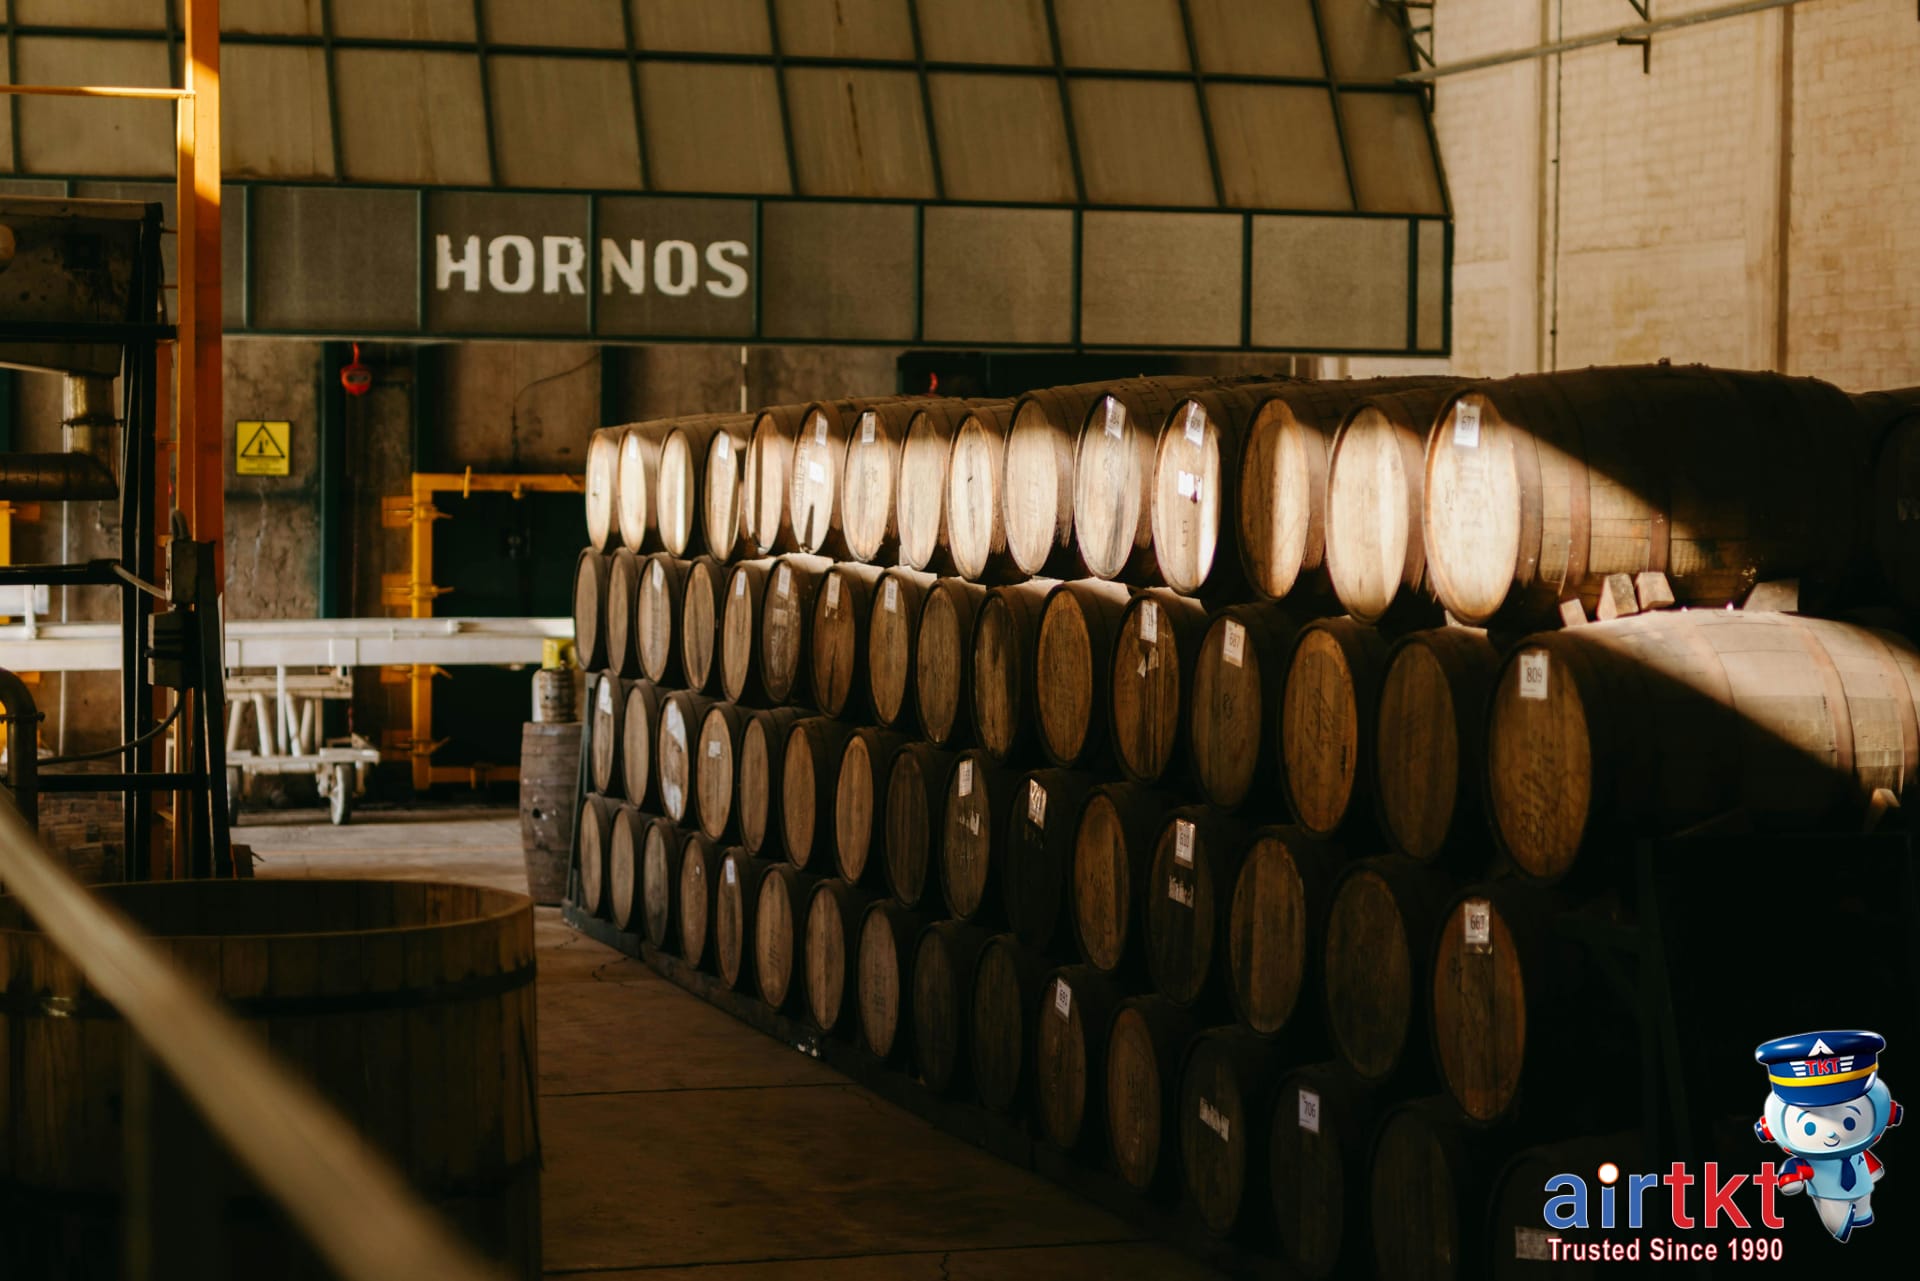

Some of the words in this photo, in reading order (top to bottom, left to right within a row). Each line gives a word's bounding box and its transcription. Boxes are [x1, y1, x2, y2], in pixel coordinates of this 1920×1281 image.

[436, 234, 749, 298] HORNOS
[1526, 666, 1543, 684] 809
[1303, 1100, 1317, 1119] 706
